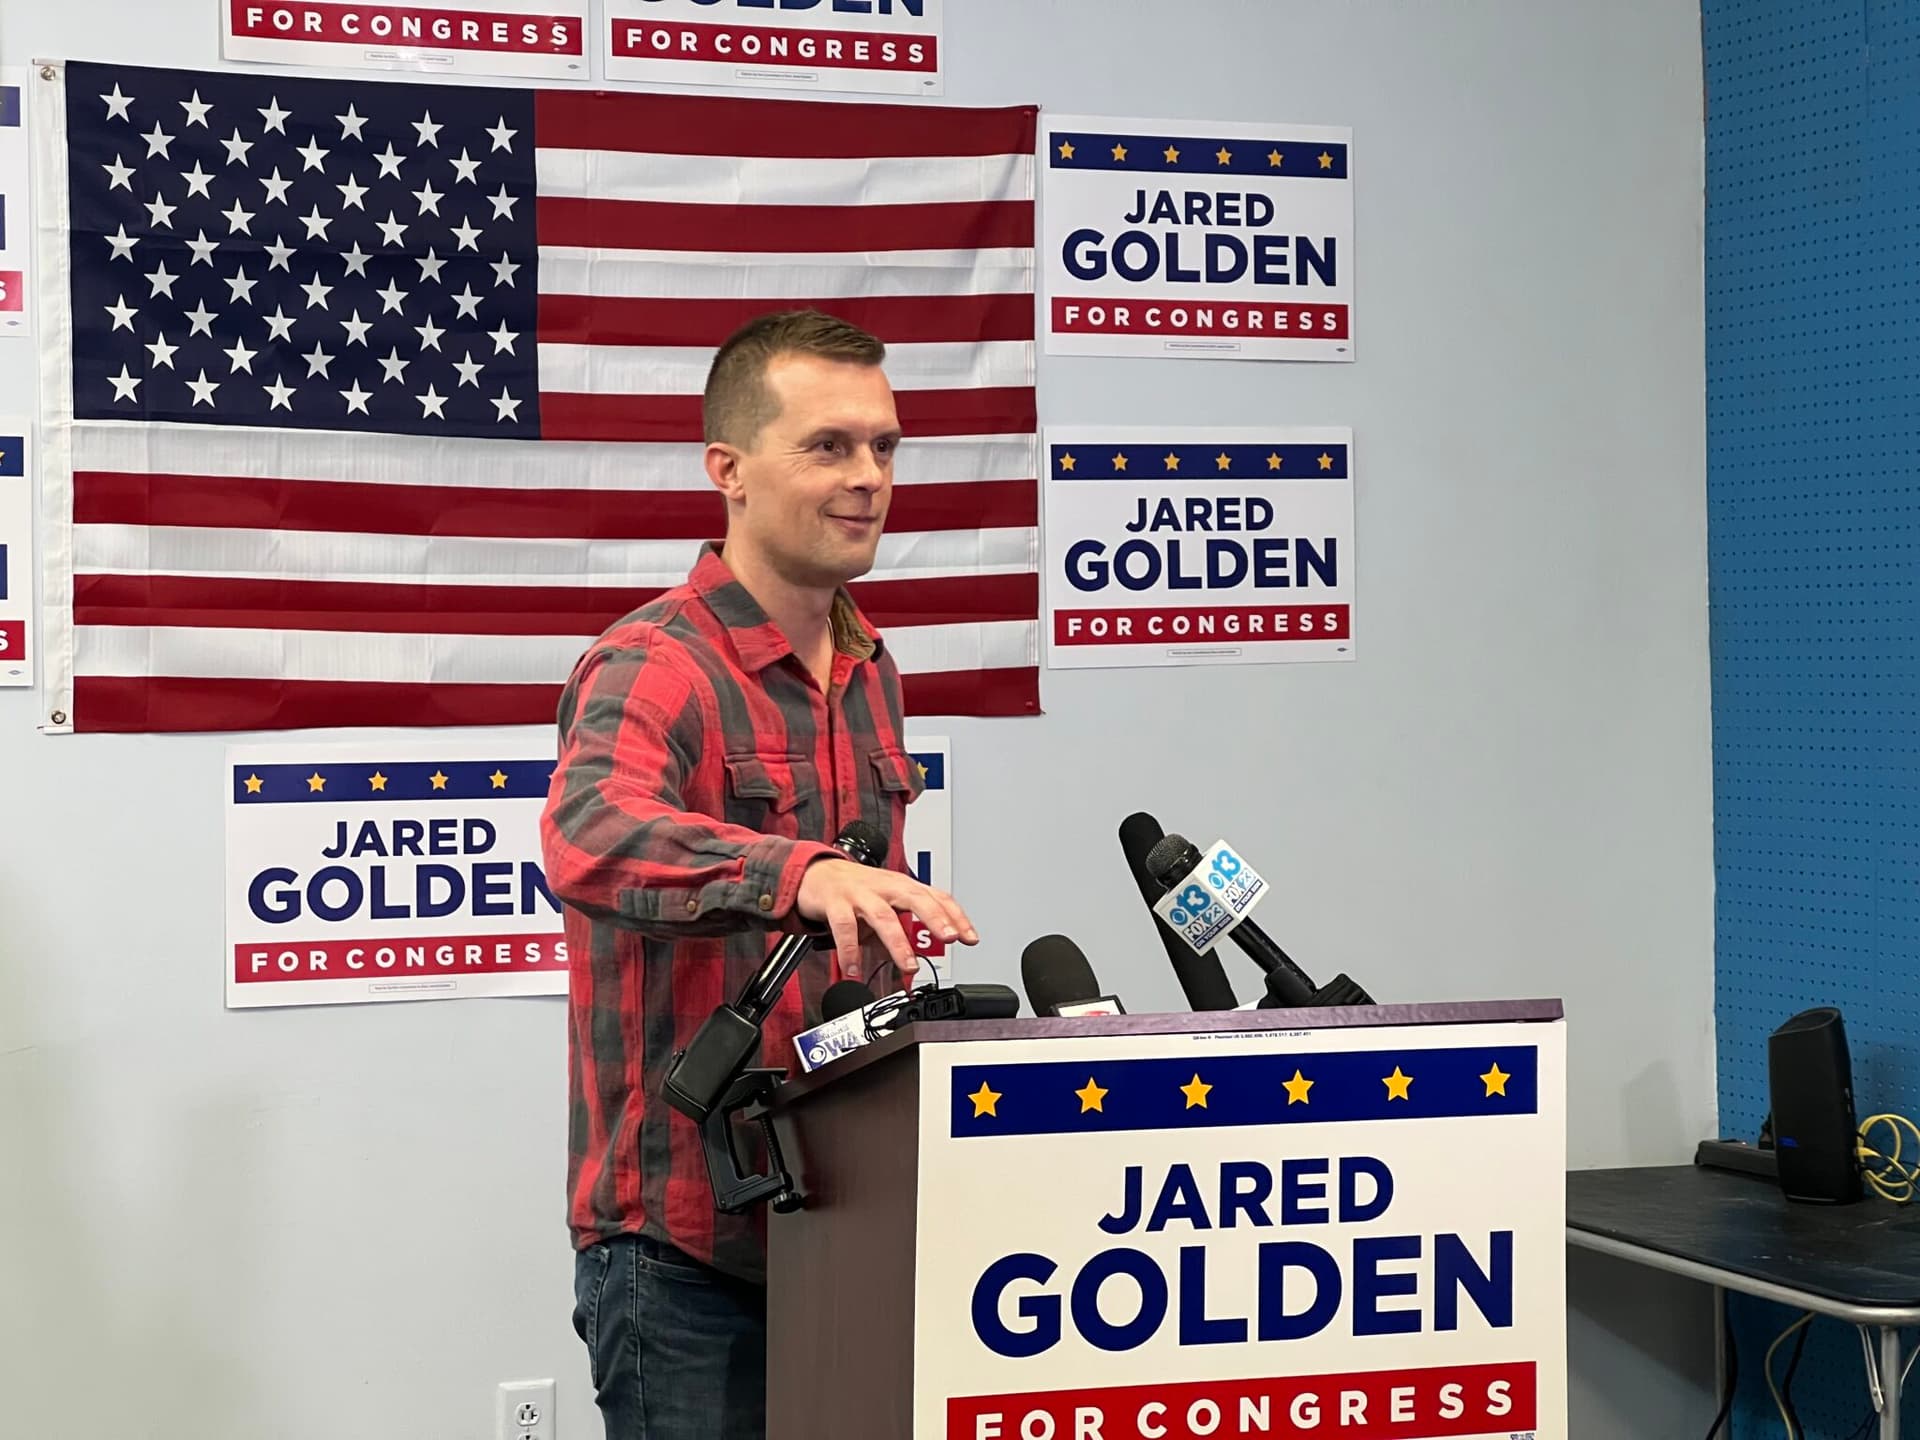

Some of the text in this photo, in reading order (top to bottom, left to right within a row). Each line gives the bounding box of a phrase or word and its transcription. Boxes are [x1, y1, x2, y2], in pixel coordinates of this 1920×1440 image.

[247, 8, 568, 45] FOR CONGRESS
[627, 28, 923, 62] FOR CONGRESS
[1124, 189, 1274, 227] JARED
[1062, 228, 1336, 286] GOLDEN
[1065, 306, 1337, 331] FOR CONGRESS
[1125, 497, 1274, 533] JARED
[1064, 538, 1337, 592] GOLDEN
[1068, 613, 1338, 637] FOR CONGRESS
[322, 818, 496, 858] JARED
[1212, 850, 1241, 881] 13
[1176, 884, 1211, 918] 13
[1223, 882, 1244, 906] FOX
[1184, 917, 1210, 942] FOX
[251, 941, 569, 973] FOR CONGRESS
[1097, 1156, 1394, 1235] JARED
[971, 1231, 1513, 1359] GOLDEN
[976, 1379, 1513, 1440] FOR CONGRESS
